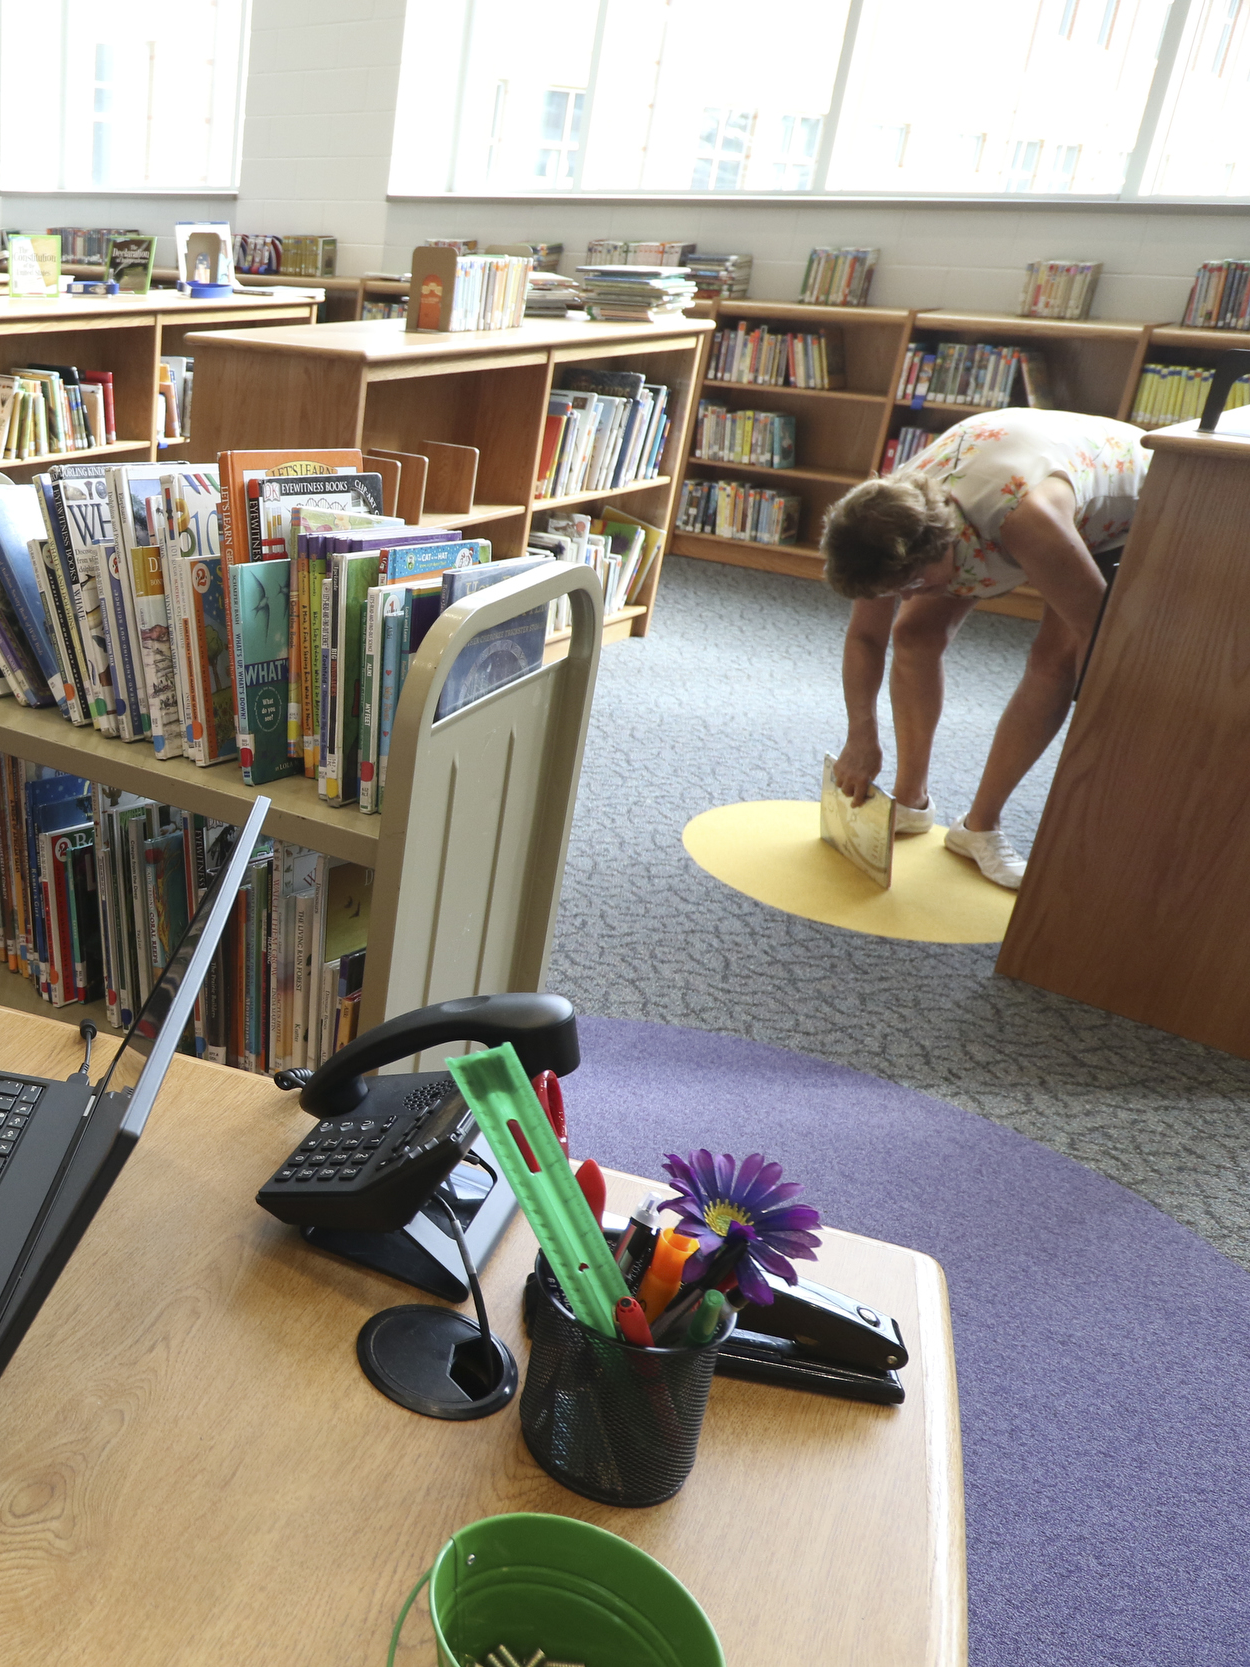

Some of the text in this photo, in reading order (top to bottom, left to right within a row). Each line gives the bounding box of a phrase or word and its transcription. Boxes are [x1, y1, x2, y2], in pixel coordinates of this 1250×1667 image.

[281, 481, 348, 495] EYEWITNESS BOOKS
[118, 492, 127, 524] Elephants
[220, 486, 233, 546] LET'S LEARN
[53, 487, 86, 622] EYEWITNESS BOOKS WHALE
[49, 540, 75, 631] WHALES AND DOLPHINS
[235, 634, 243, 658] WHAT'S
[196, 829, 206, 888] EYEWITNESS
[296, 949, 304, 966] RAIN
[295, 966, 303, 993] FOREST
